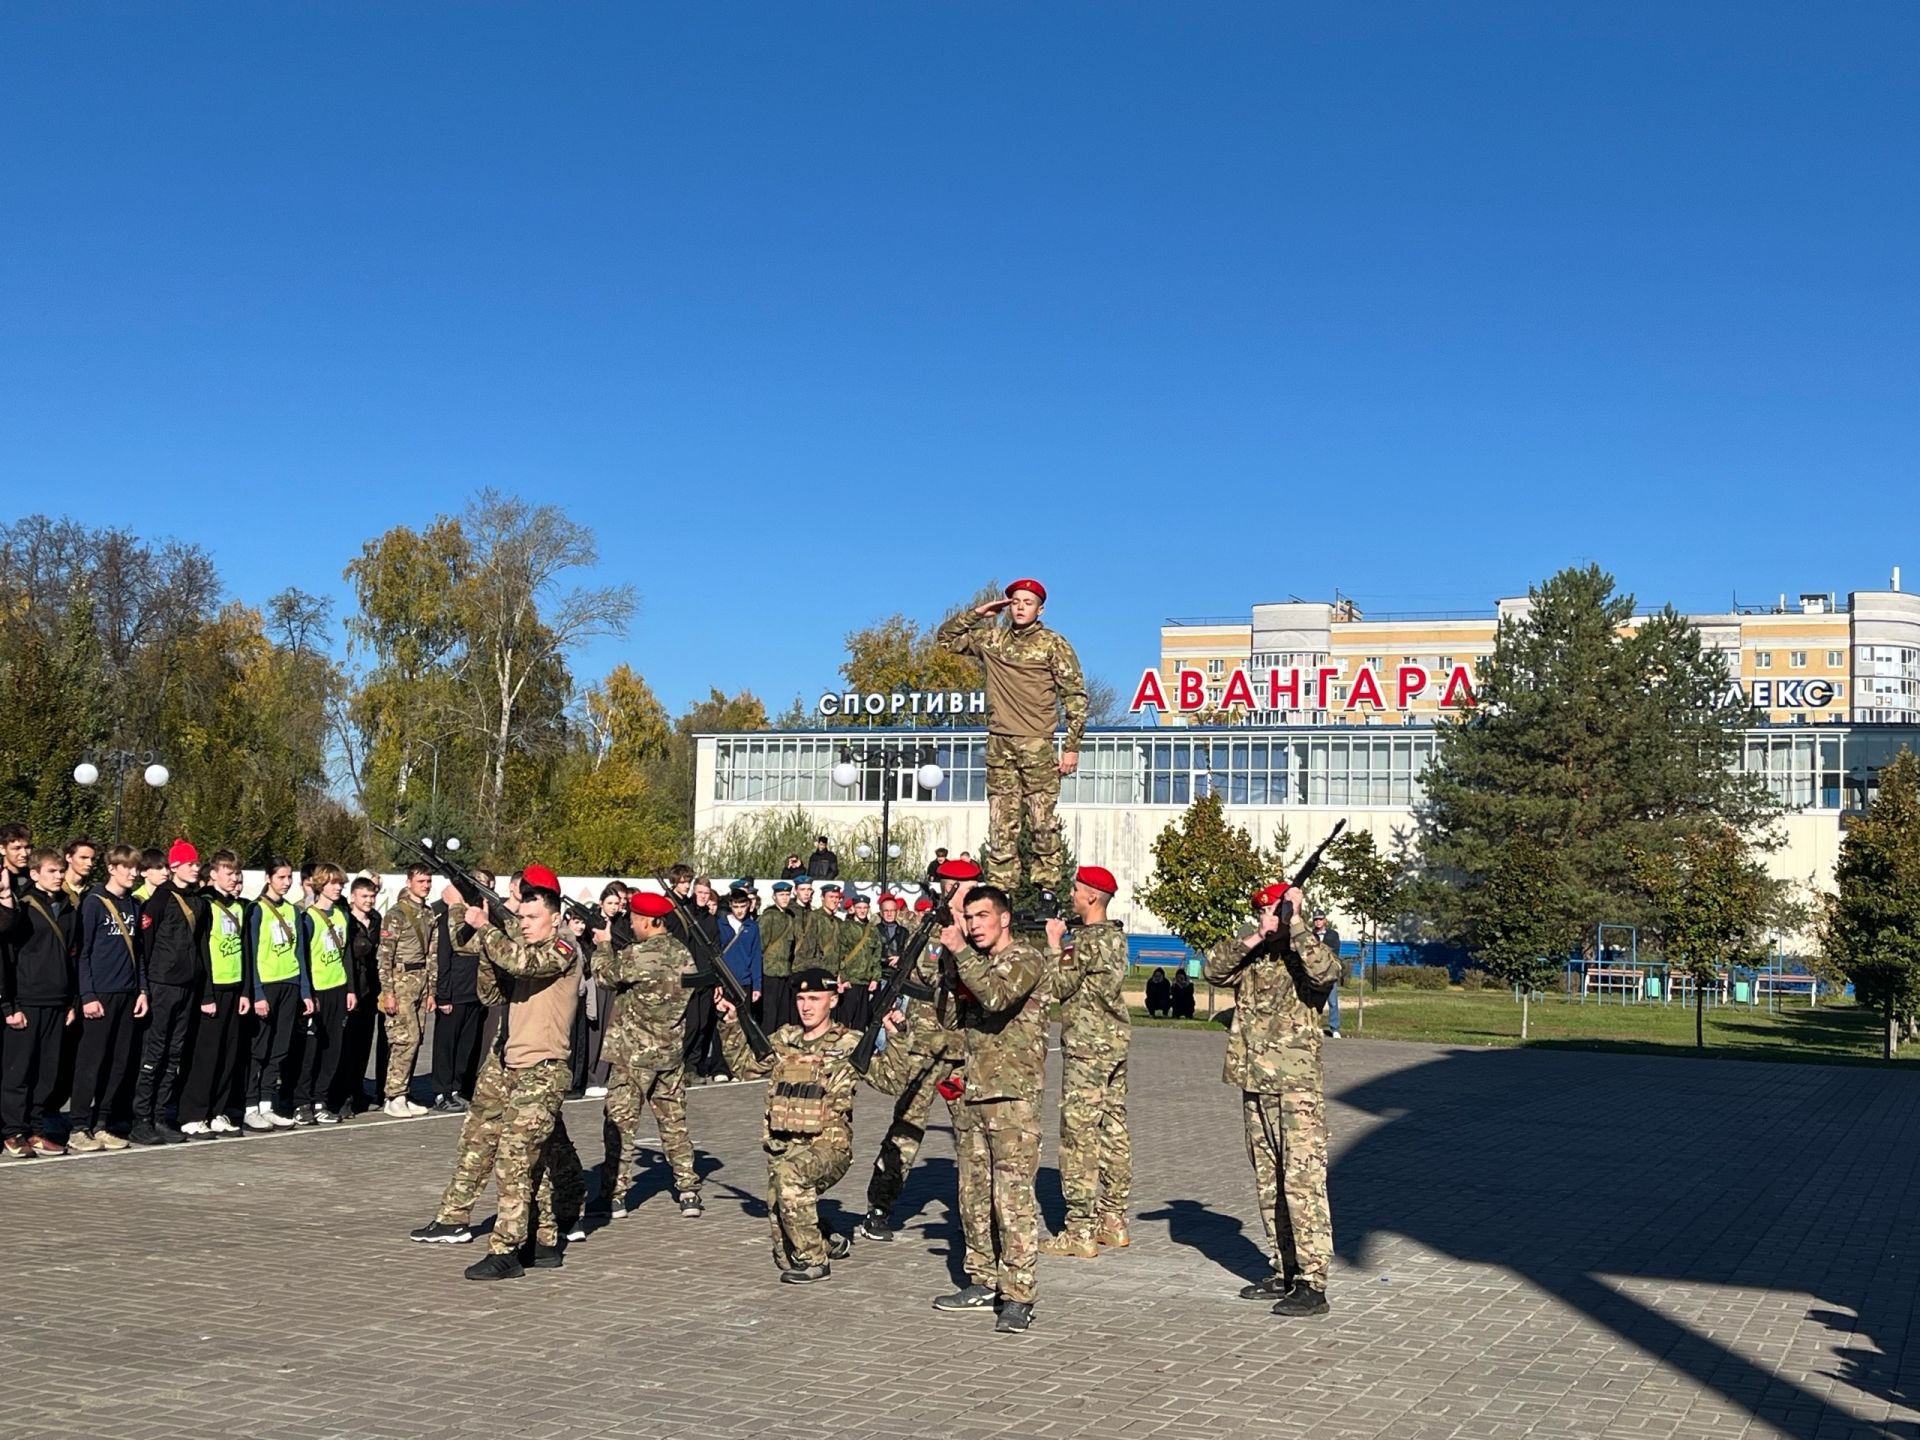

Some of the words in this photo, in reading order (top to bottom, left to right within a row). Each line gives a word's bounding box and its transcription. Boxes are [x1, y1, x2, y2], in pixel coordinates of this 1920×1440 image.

[818, 692, 986, 715] СПОРТИВН
[1129, 663, 1479, 712] АВАНГАРД
[1721, 680, 1834, 707] ЛЕКС
